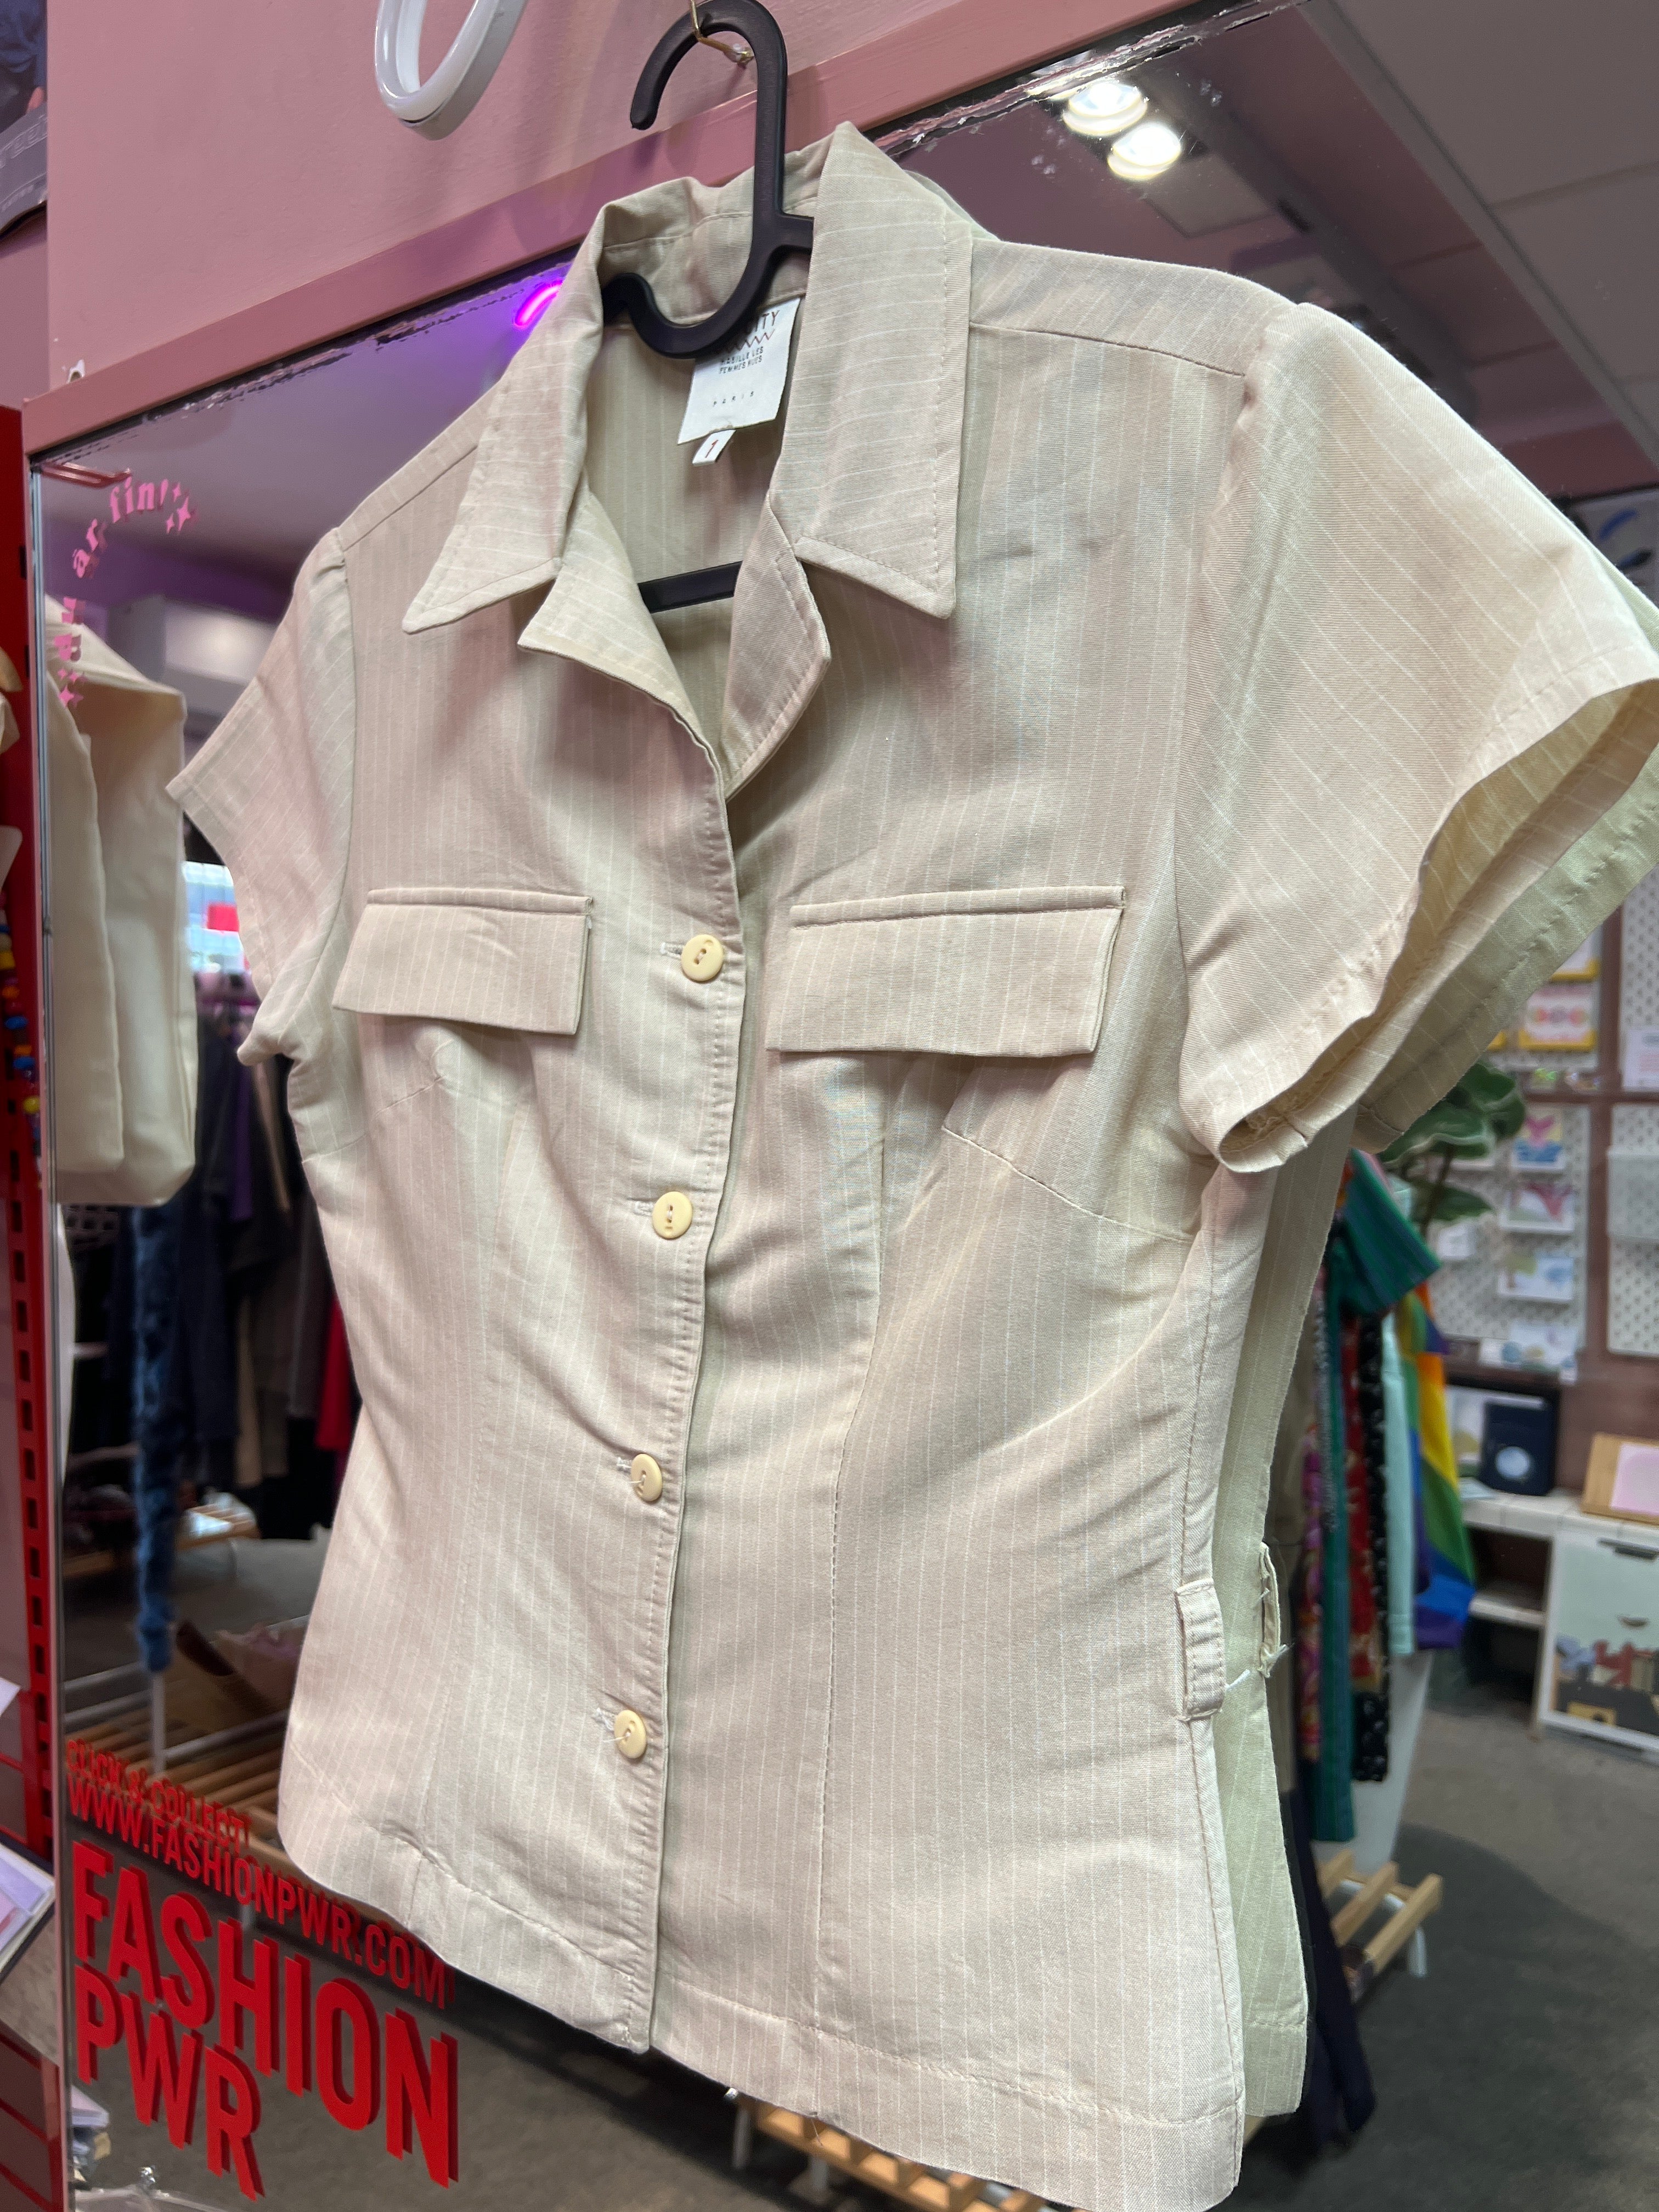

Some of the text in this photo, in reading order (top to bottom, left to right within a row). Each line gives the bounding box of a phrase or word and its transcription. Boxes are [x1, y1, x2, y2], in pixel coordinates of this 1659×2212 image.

[705, 439, 719, 458] 1
[67, 1773, 444, 2009] WWW.FASHIONPWR.COM
[73, 1842, 450, 2189] FASHION
[75, 1965, 257, 2202] PWR
